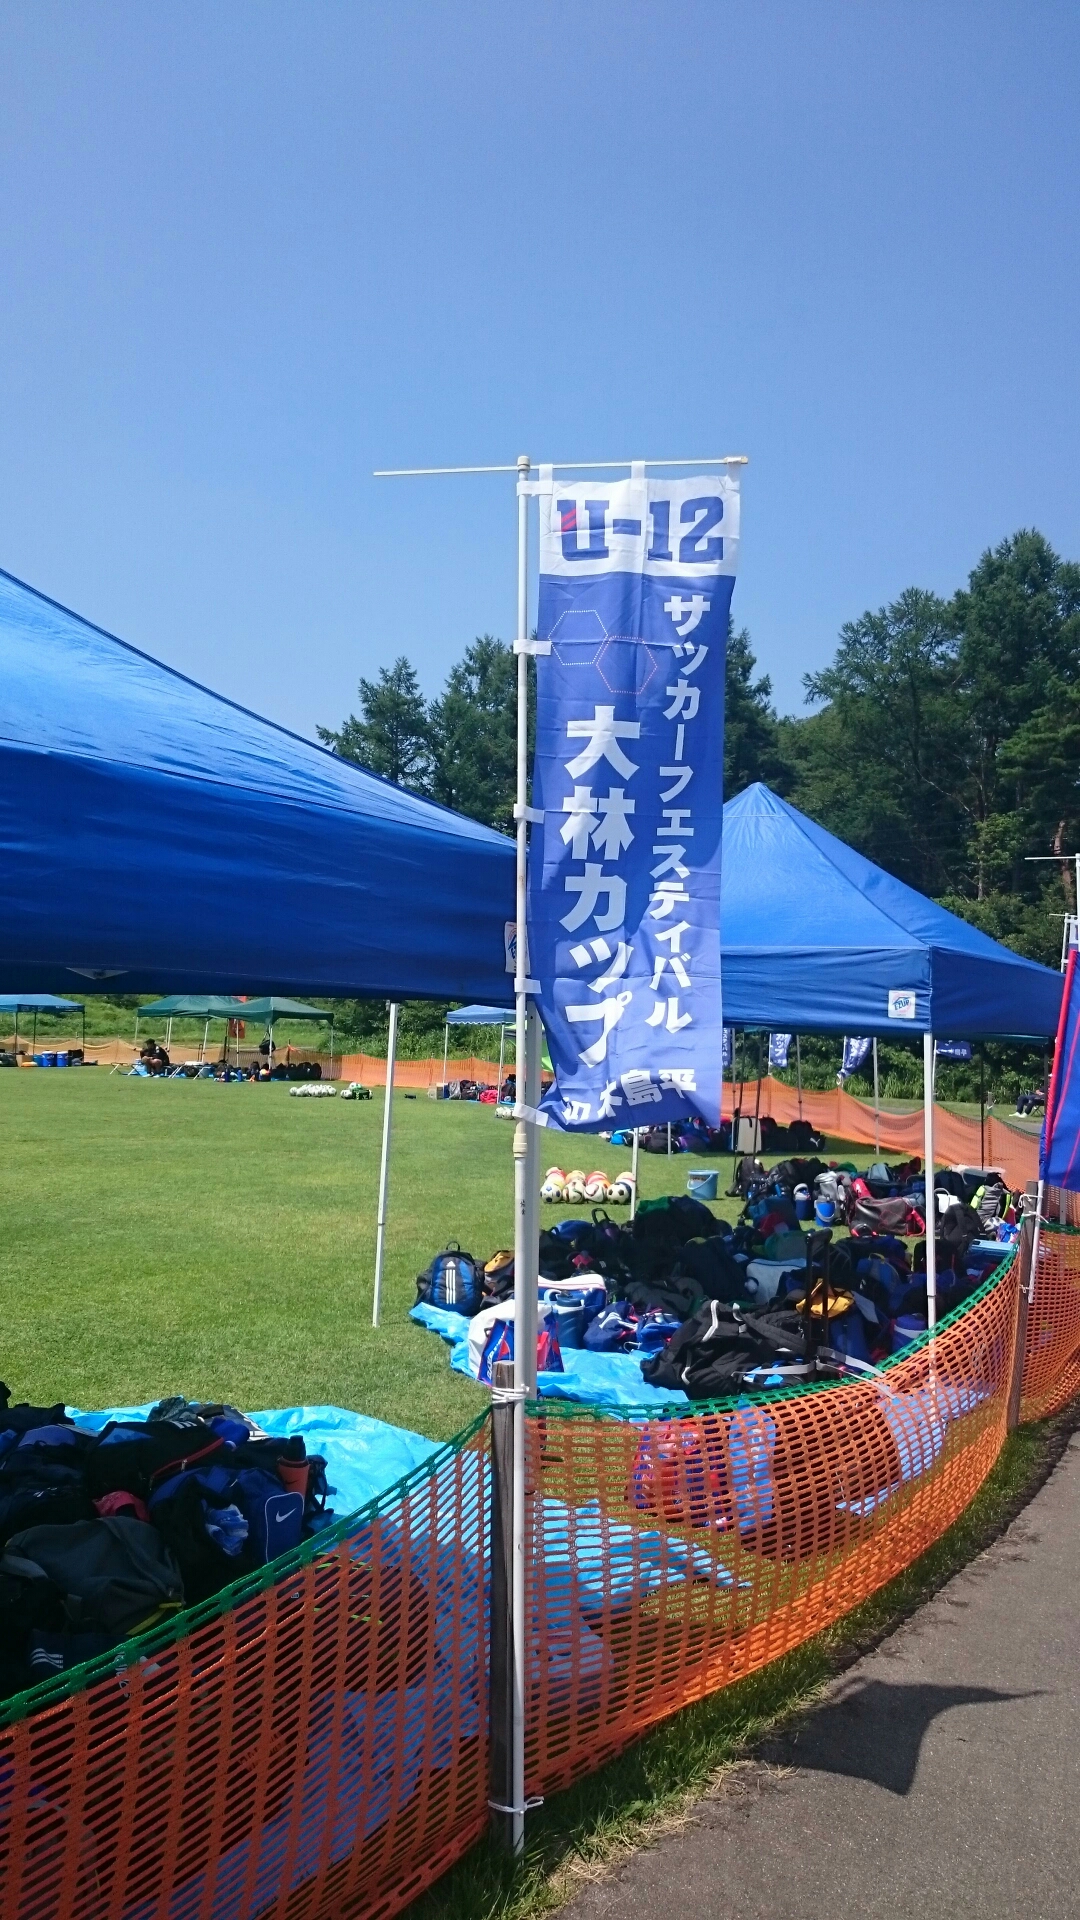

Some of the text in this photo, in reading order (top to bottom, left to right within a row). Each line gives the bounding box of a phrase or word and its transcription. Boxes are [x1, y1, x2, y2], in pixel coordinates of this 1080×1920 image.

[557, 496, 724, 563] U-12
[559, 705, 641, 1069] 大林カップ
[645, 594, 711, 1034] サッカーフェスティバル
